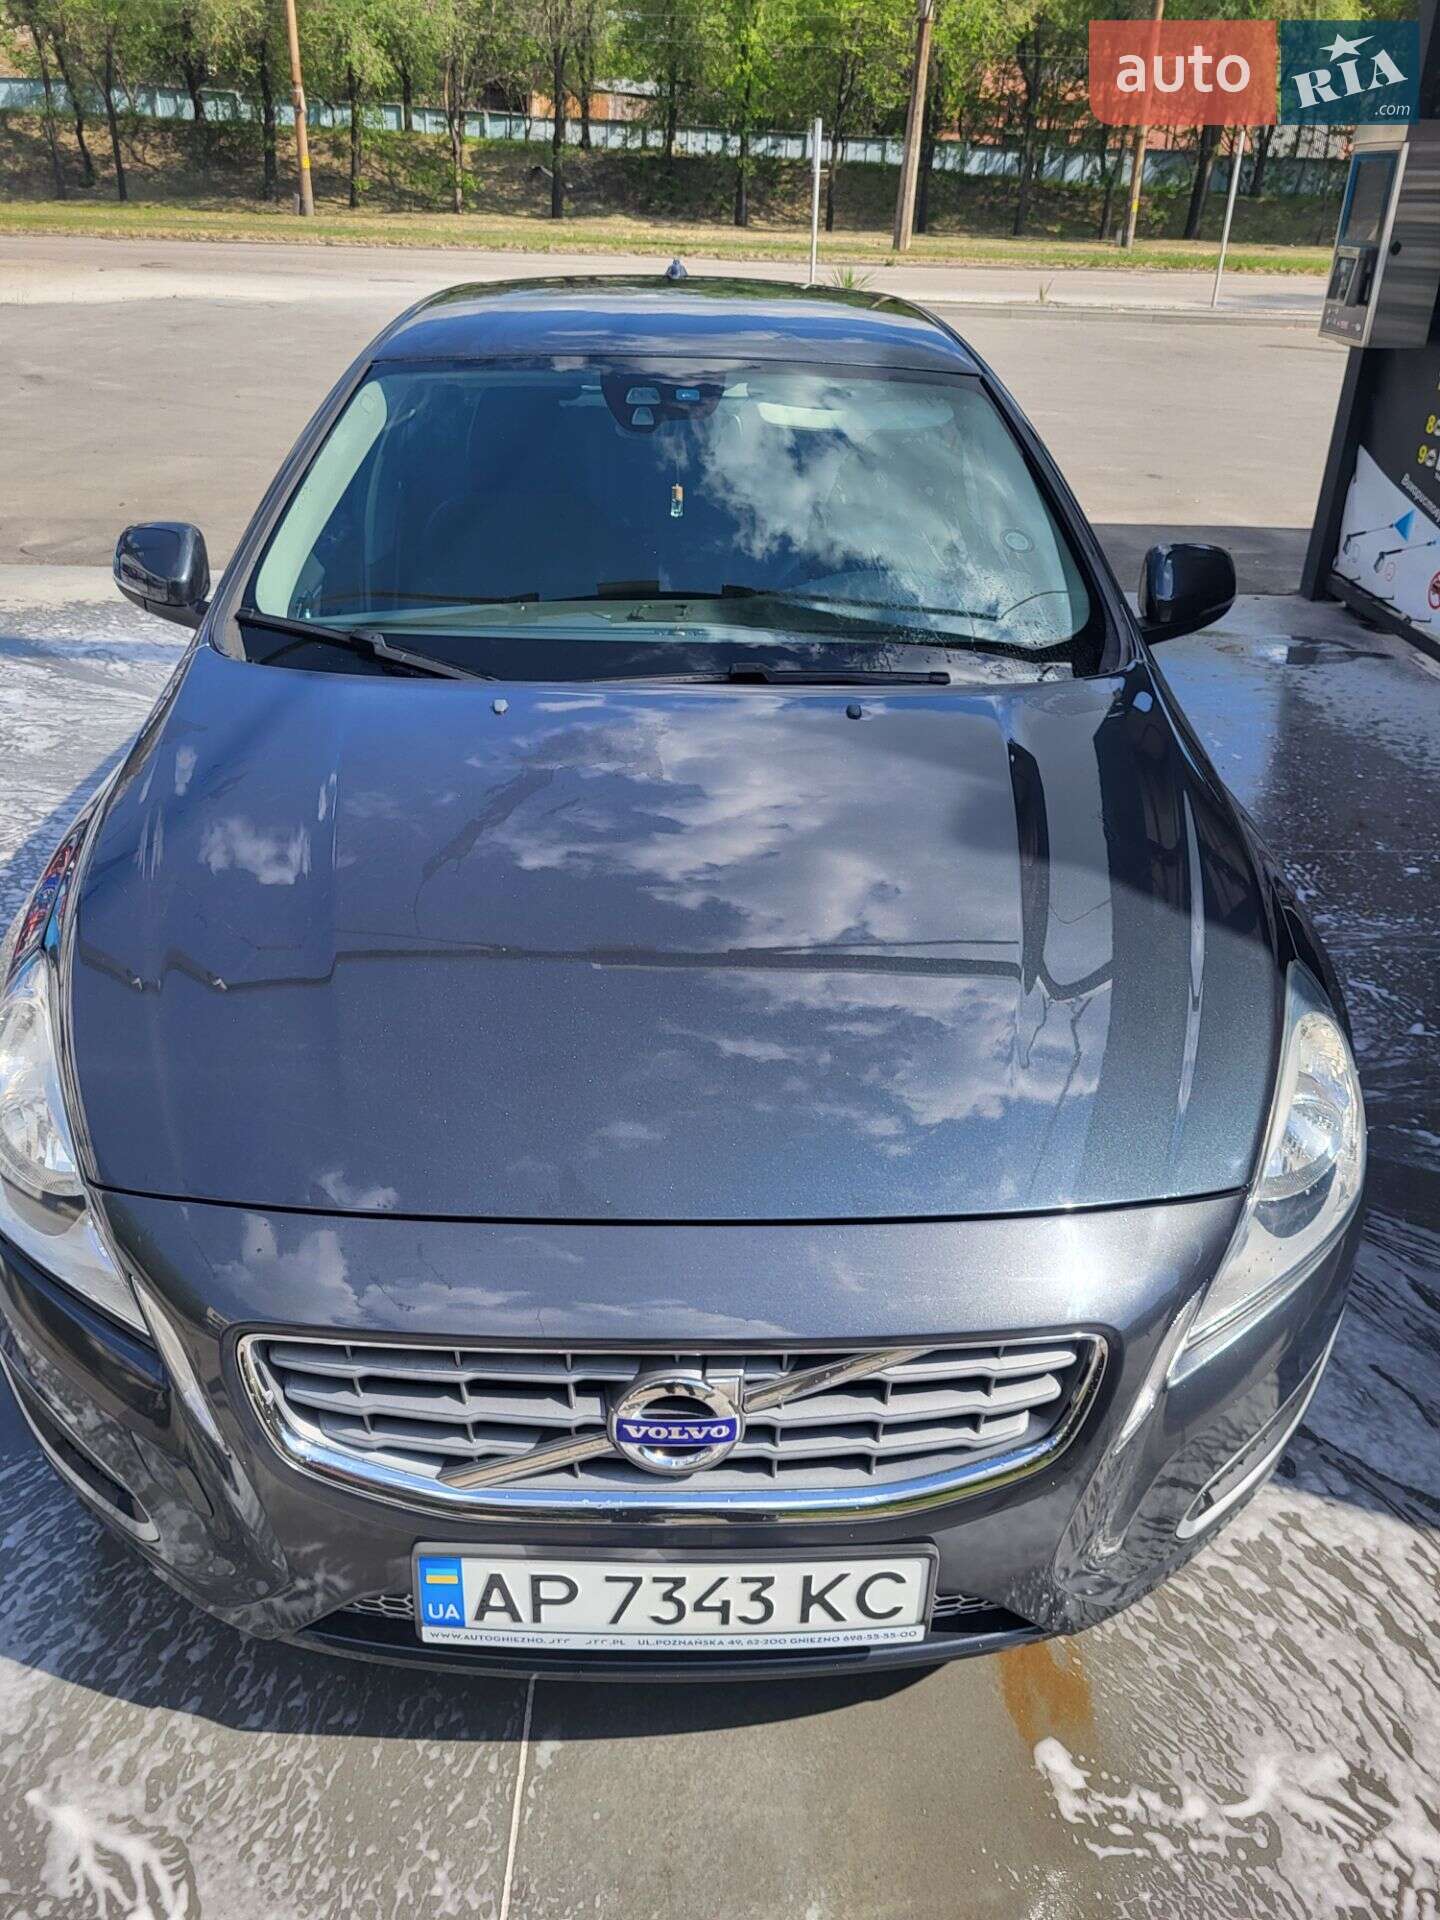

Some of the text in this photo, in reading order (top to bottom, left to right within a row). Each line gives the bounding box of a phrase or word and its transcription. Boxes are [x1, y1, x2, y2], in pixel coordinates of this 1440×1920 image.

[1425, 414, 1437, 434] 8
[1417, 444, 1428, 464] 9
[622, 1425, 730, 1440] VOLVO
[473, 1571, 908, 1625] AP 7343 KC
[428, 1602, 459, 1621] UA
[746, 1638, 787, 1646] 62-200
[790, 1636, 840, 1645] GNIEZNO
